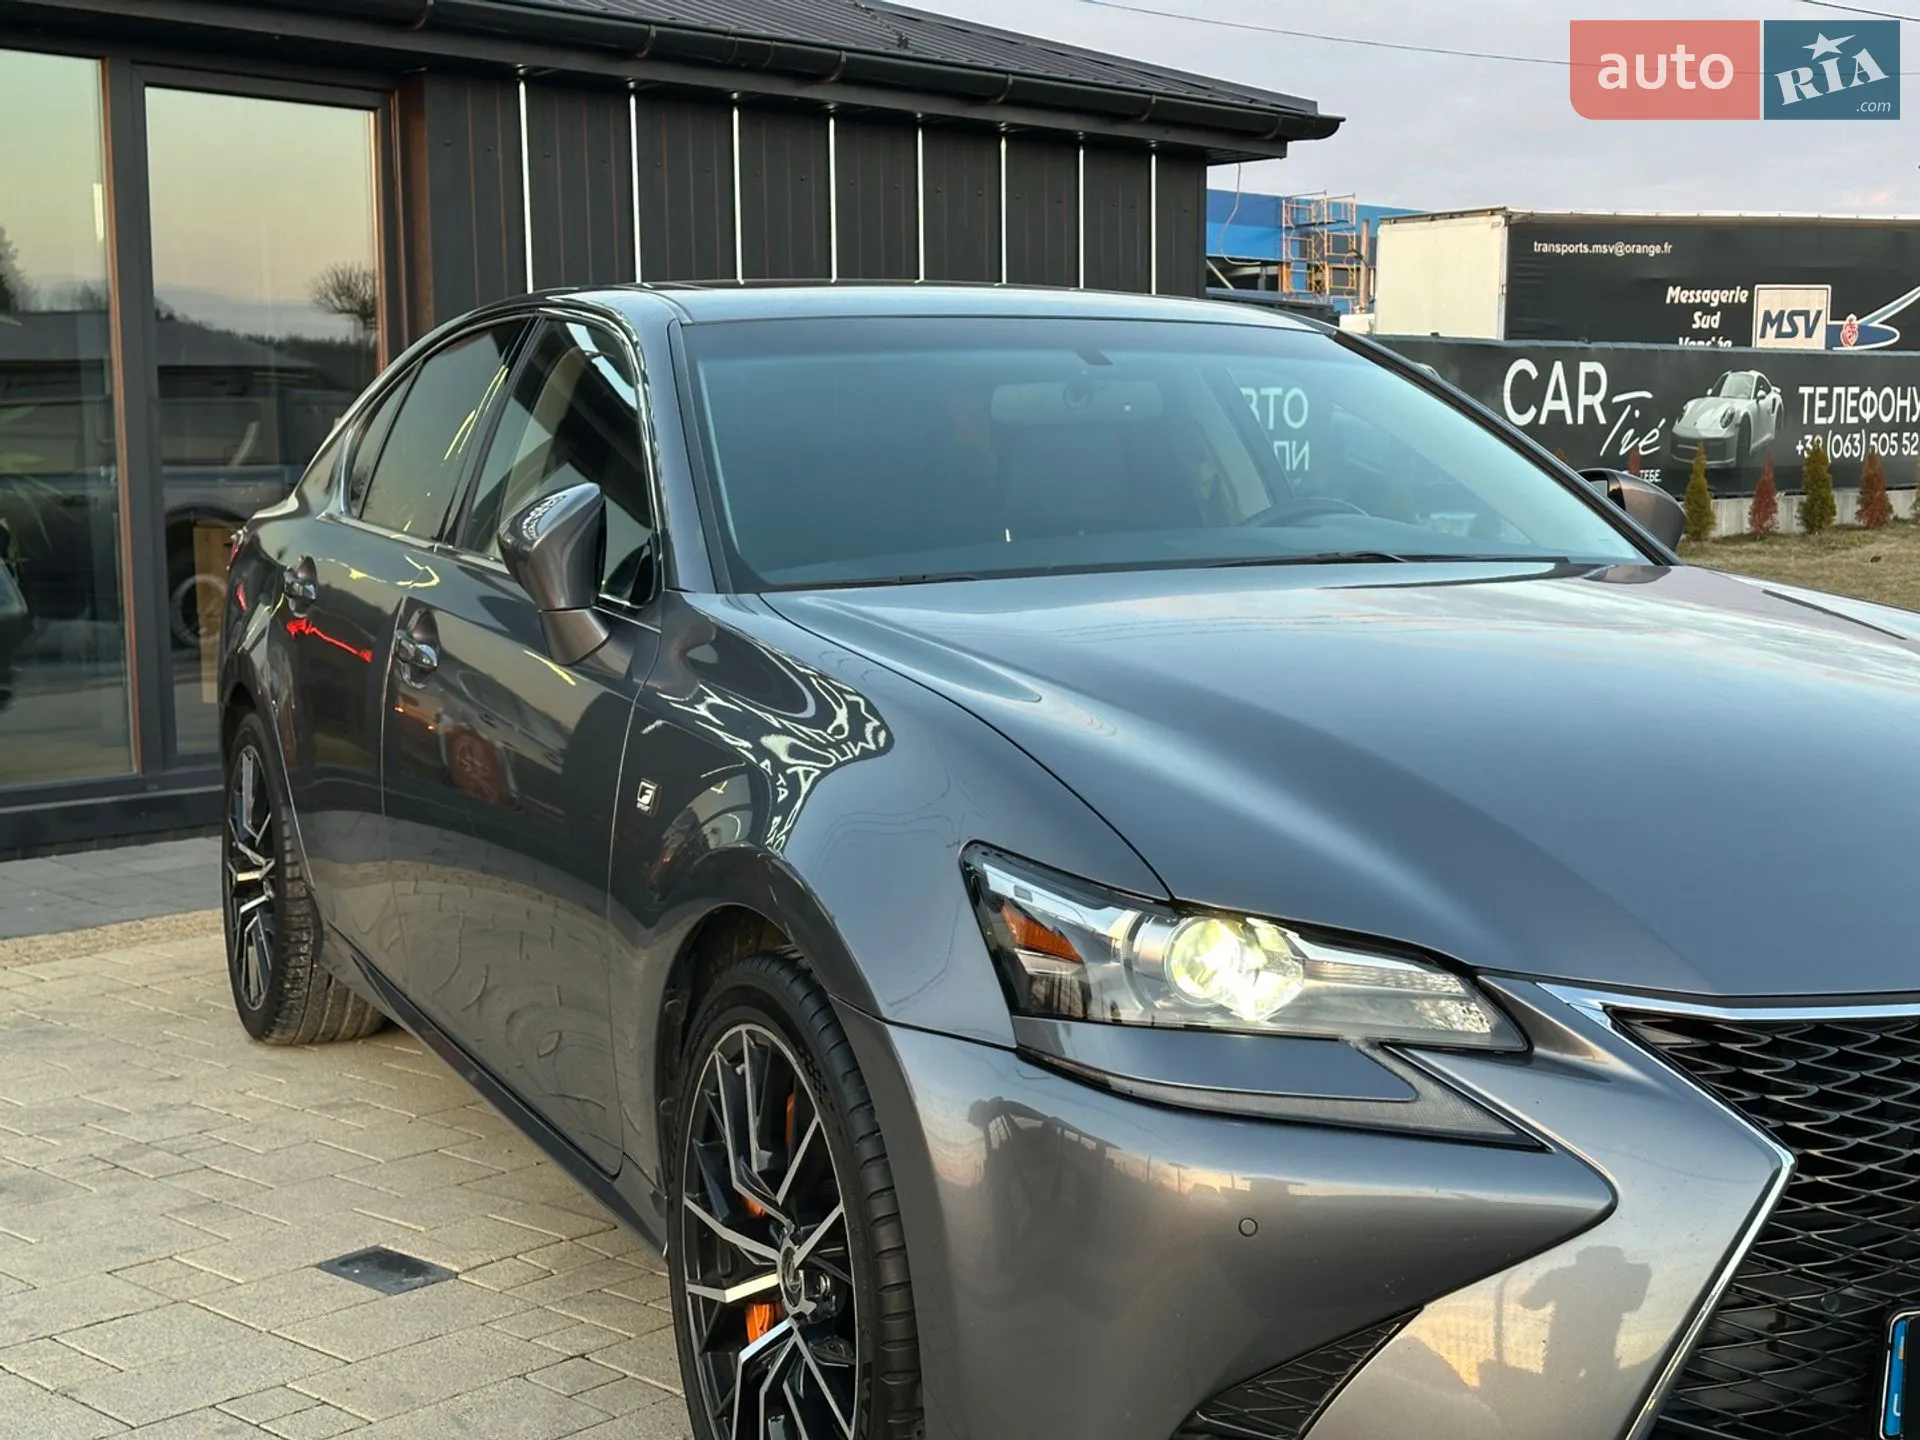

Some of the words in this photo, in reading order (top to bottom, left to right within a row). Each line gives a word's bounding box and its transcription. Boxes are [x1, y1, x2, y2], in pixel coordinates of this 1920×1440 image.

[1533, 240, 1673, 257] transports.msv@orange.fr
[1666, 286, 1749, 307] Messagerie
[1692, 311, 1721, 329] Sud
[1759, 309, 1823, 339] MSV
[1503, 358, 1608, 427] CAR
[1827, 429, 1866, 463] (063)
[1869, 432, 1899, 457] 505
[1902, 432, 1919, 456] 52
